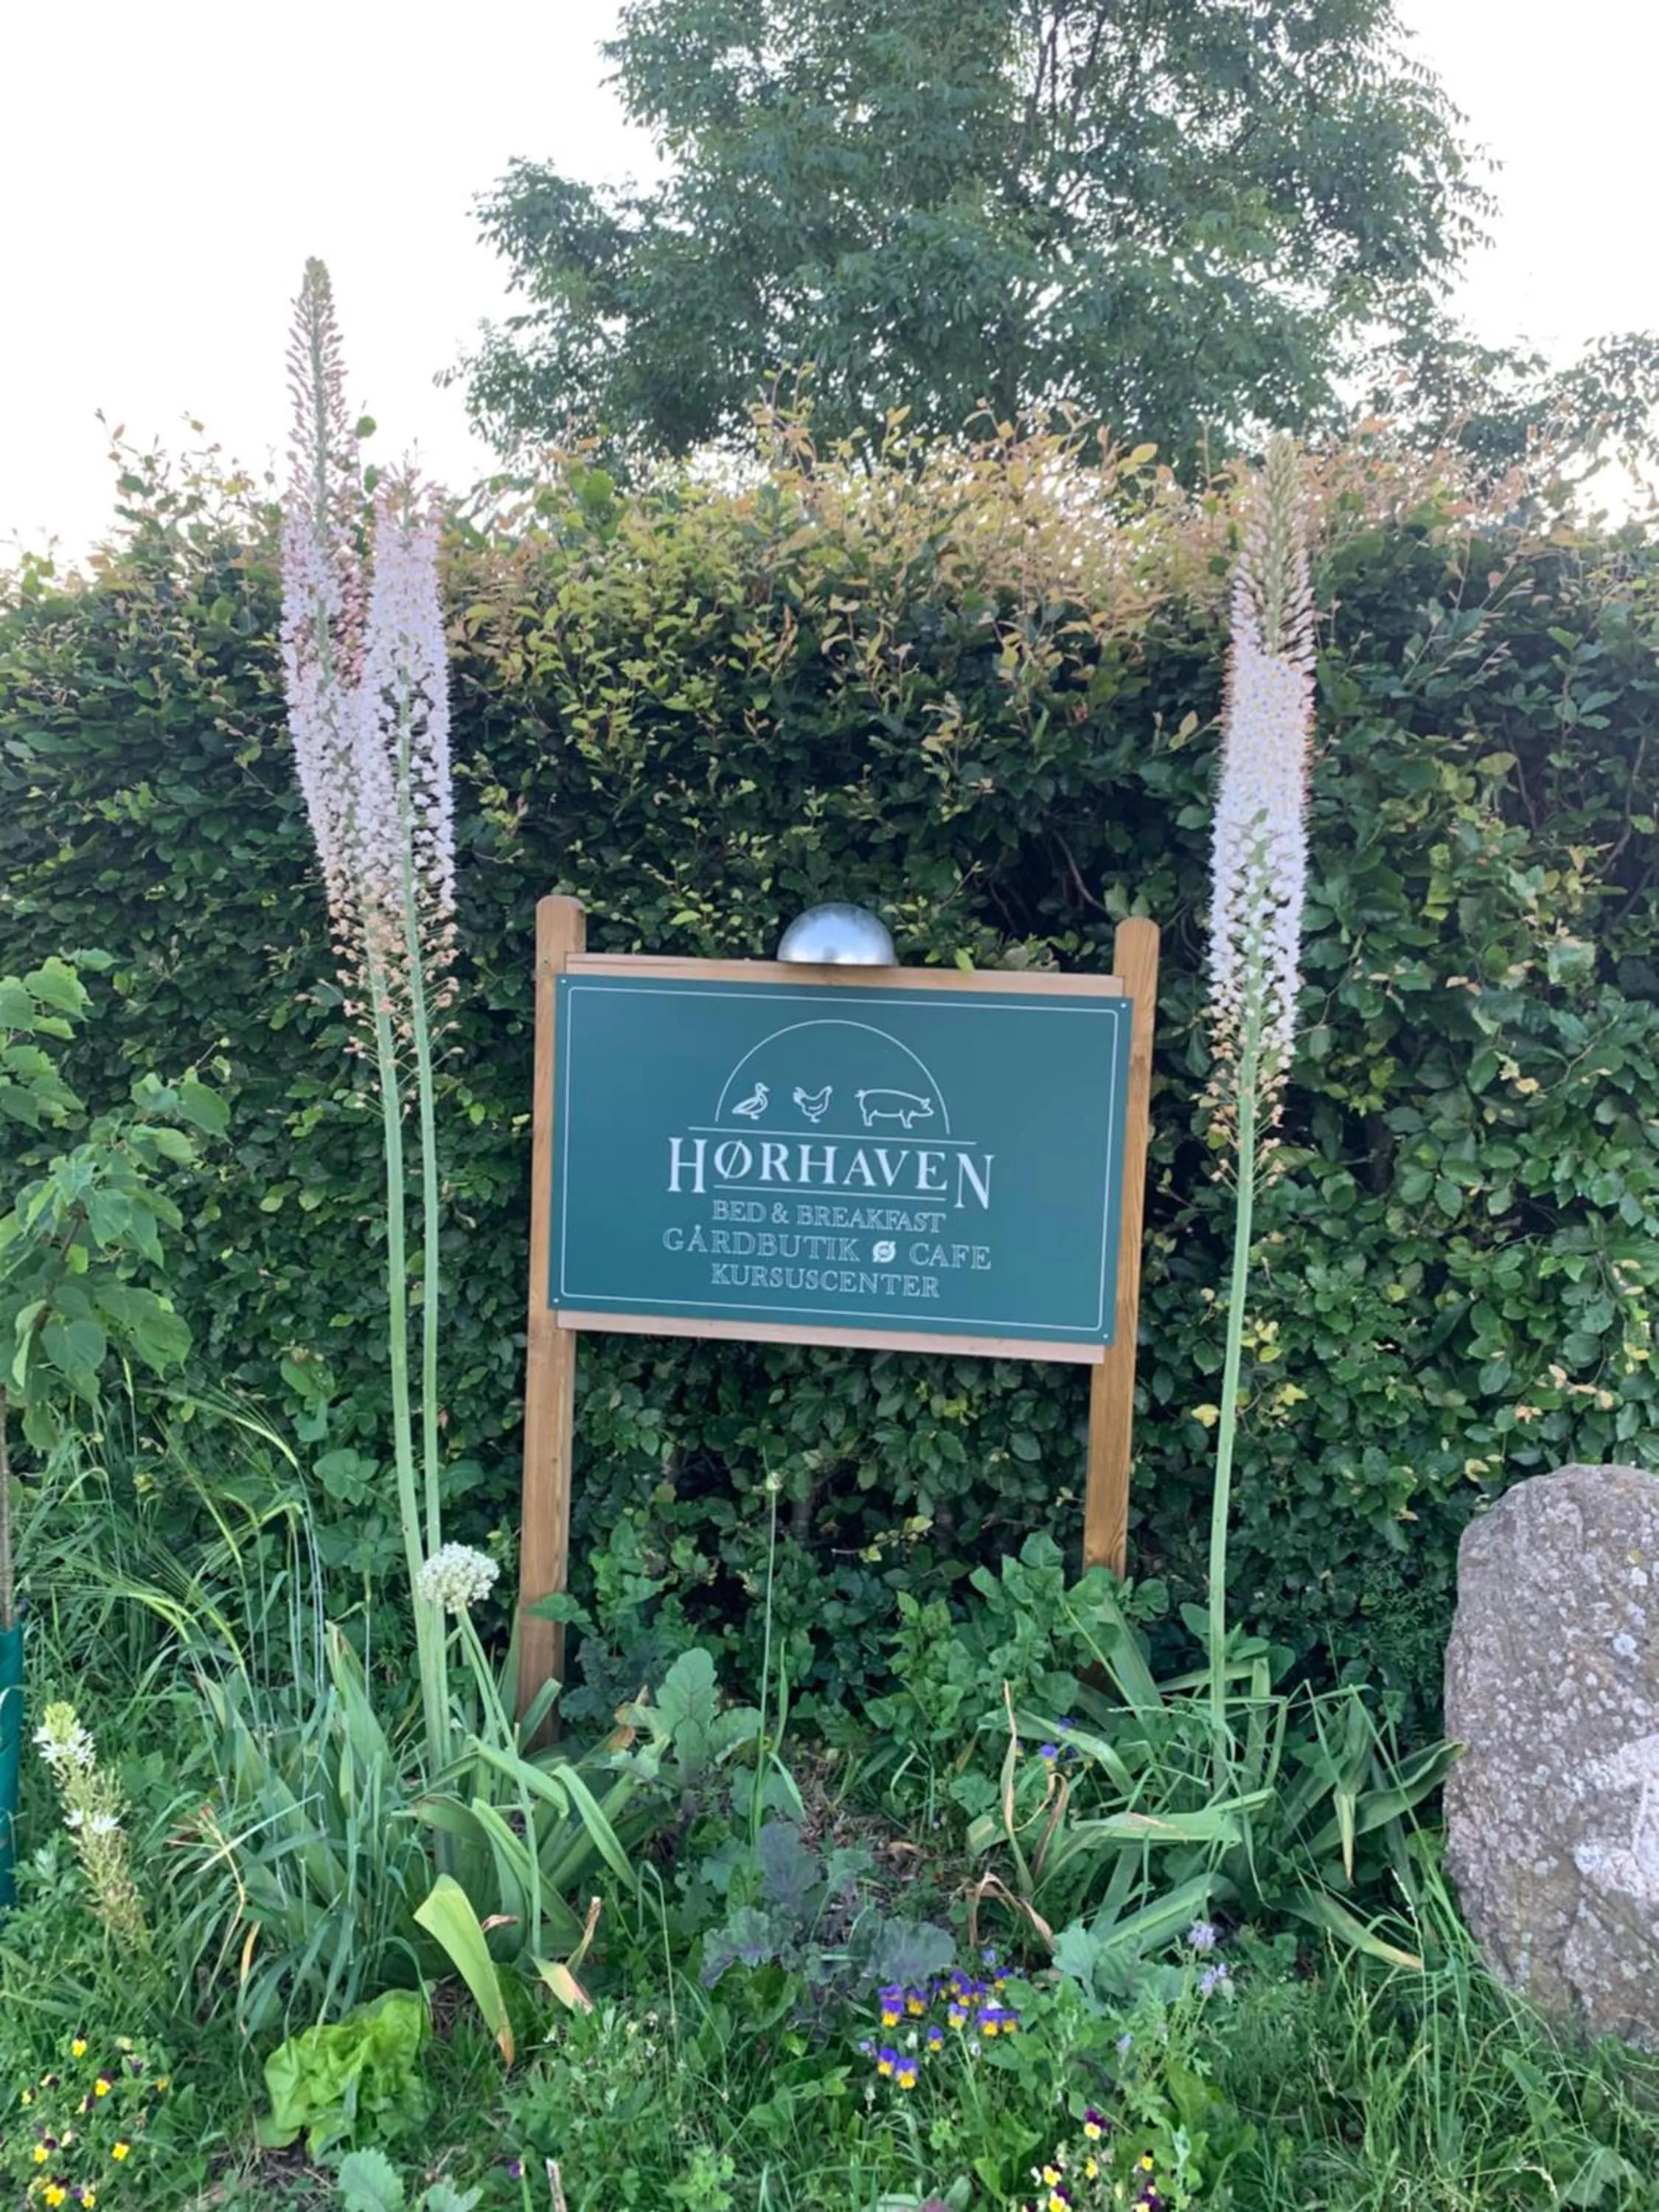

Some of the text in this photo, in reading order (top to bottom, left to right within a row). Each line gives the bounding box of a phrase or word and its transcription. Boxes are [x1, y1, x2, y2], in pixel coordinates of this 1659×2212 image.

[667, 1137, 996, 1209] HØRHAVEN
[712, 1200, 947, 1233] BED & BREAKFAST
[663, 1225, 860, 1262] GÅRDBUTIK
[909, 1242, 992, 1270] CAFE
[711, 1263, 940, 1298] KURSUSCENTER
